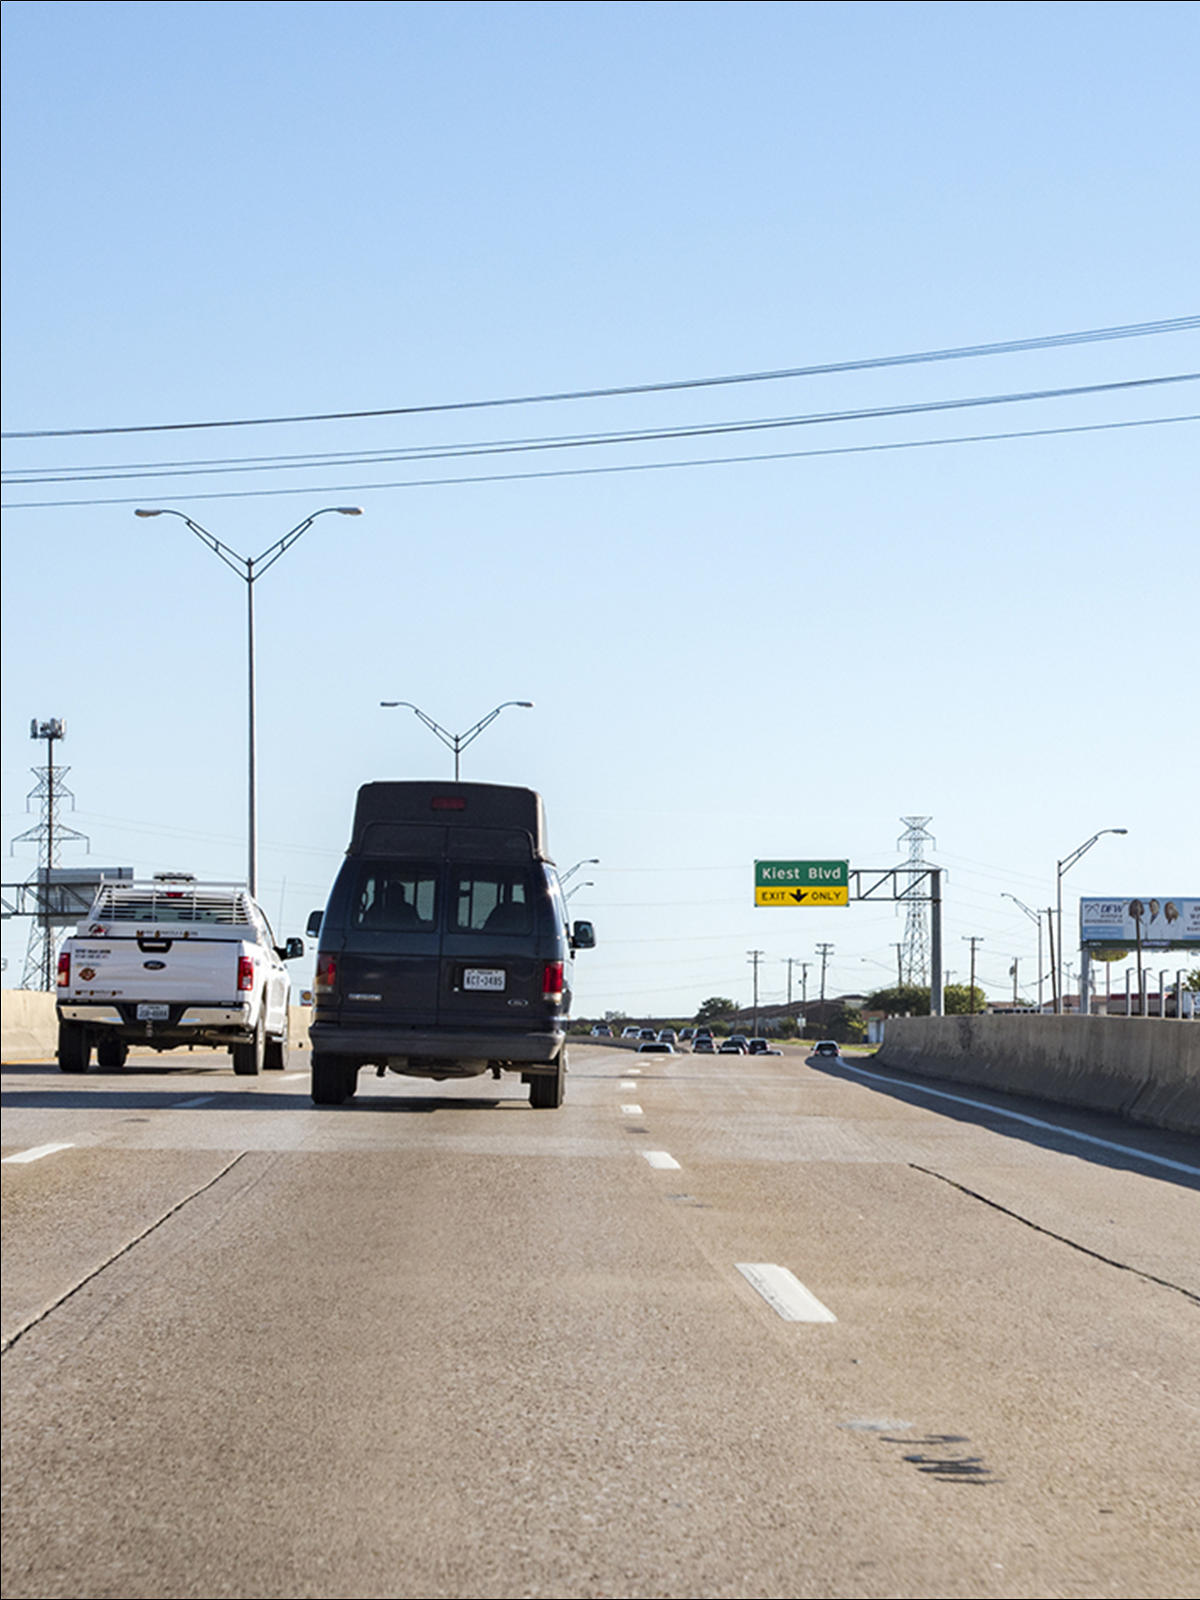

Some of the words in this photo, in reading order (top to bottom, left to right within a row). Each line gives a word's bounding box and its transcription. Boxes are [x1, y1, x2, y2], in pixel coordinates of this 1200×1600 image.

[762, 866, 800, 879] Kiest
[808, 867, 841, 879] Blvd
[761, 892, 786, 901] EXIT
[811, 892, 842, 901] ONLY
[1101, 903, 1124, 913] DFW
